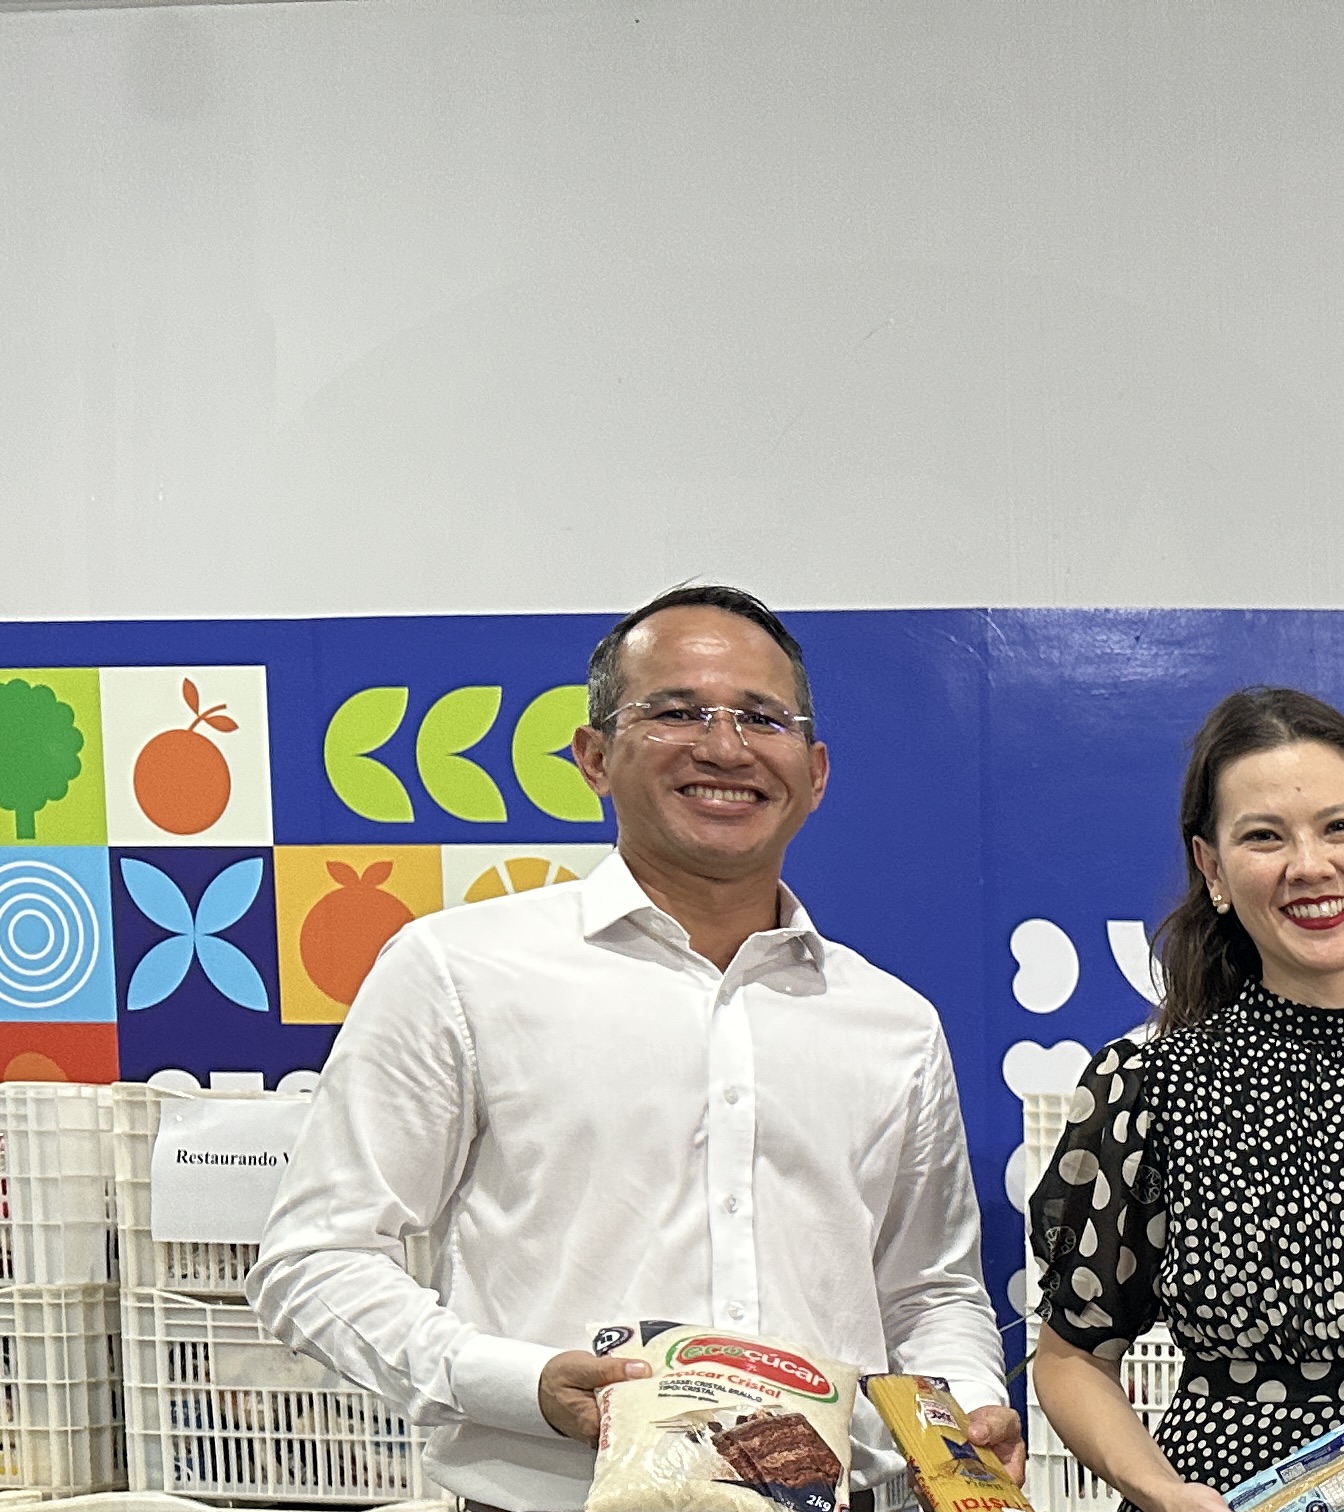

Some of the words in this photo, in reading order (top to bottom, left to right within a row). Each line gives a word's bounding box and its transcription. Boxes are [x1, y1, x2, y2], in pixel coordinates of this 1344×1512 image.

[176, 1149, 278, 1167] Restaurando
[727, 1374, 782, 1399] Cristal
[805, 1494, 832, 1512] 2kg
